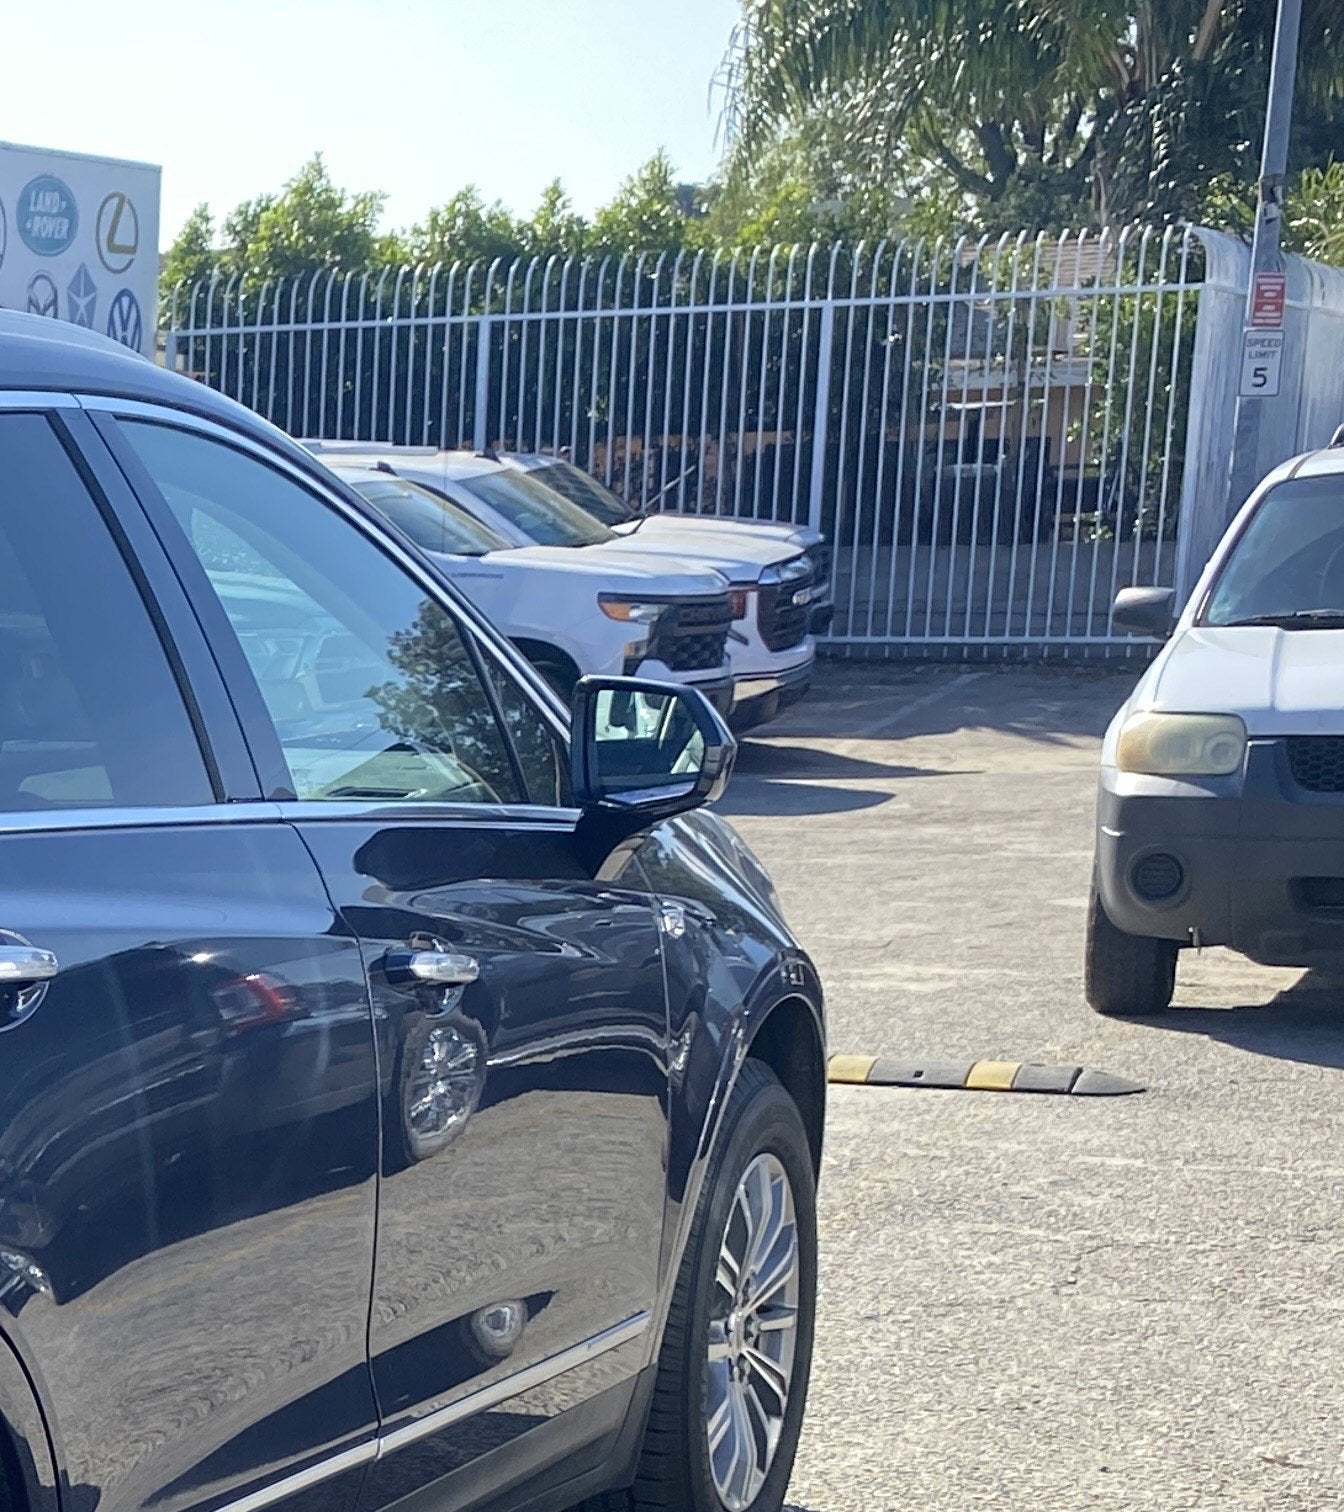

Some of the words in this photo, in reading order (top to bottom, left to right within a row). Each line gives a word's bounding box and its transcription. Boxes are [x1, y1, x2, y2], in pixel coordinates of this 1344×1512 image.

[1246, 338, 1282, 348] SPEED
[1248, 350, 1278, 359] LIMIT
[1252, 366, 1268, 388] 5
